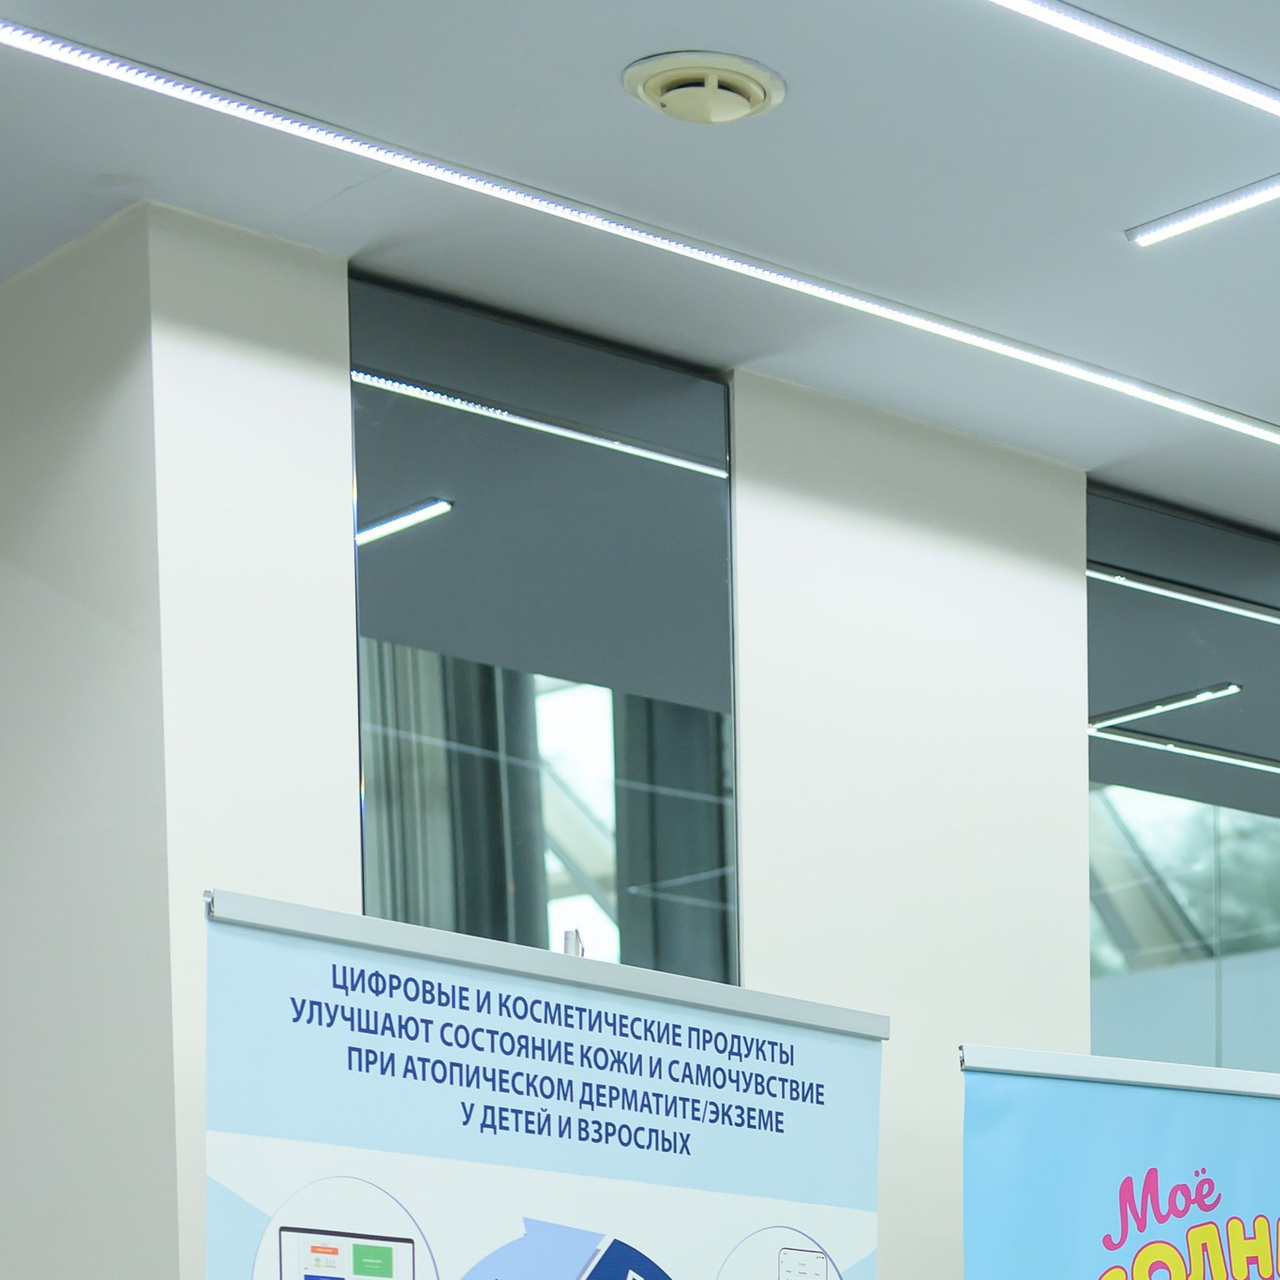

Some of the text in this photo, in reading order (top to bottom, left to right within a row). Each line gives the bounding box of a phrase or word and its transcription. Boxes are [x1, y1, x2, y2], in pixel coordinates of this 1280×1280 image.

[290, 996, 825, 1106] УЛУЧШАЮТ СОСТОЯНИЕ КОЖИ И САМОЧУВСТВИЕ
[332, 963, 794, 1066] ЦИФРОВЫЕ И КОСМЕТИЧЕСКИЕ ПРОДУКТЫ
[347, 1045, 784, 1134] ПРИ АТОПИЧЕСКОМ ДЕРМАТИТЕ/ЭКЗЕМЕ
[460, 1101, 691, 1156] У ДЕТЕЙ И ВЗРОСЛЫХ
[1102, 1167, 1222, 1251] Моё
